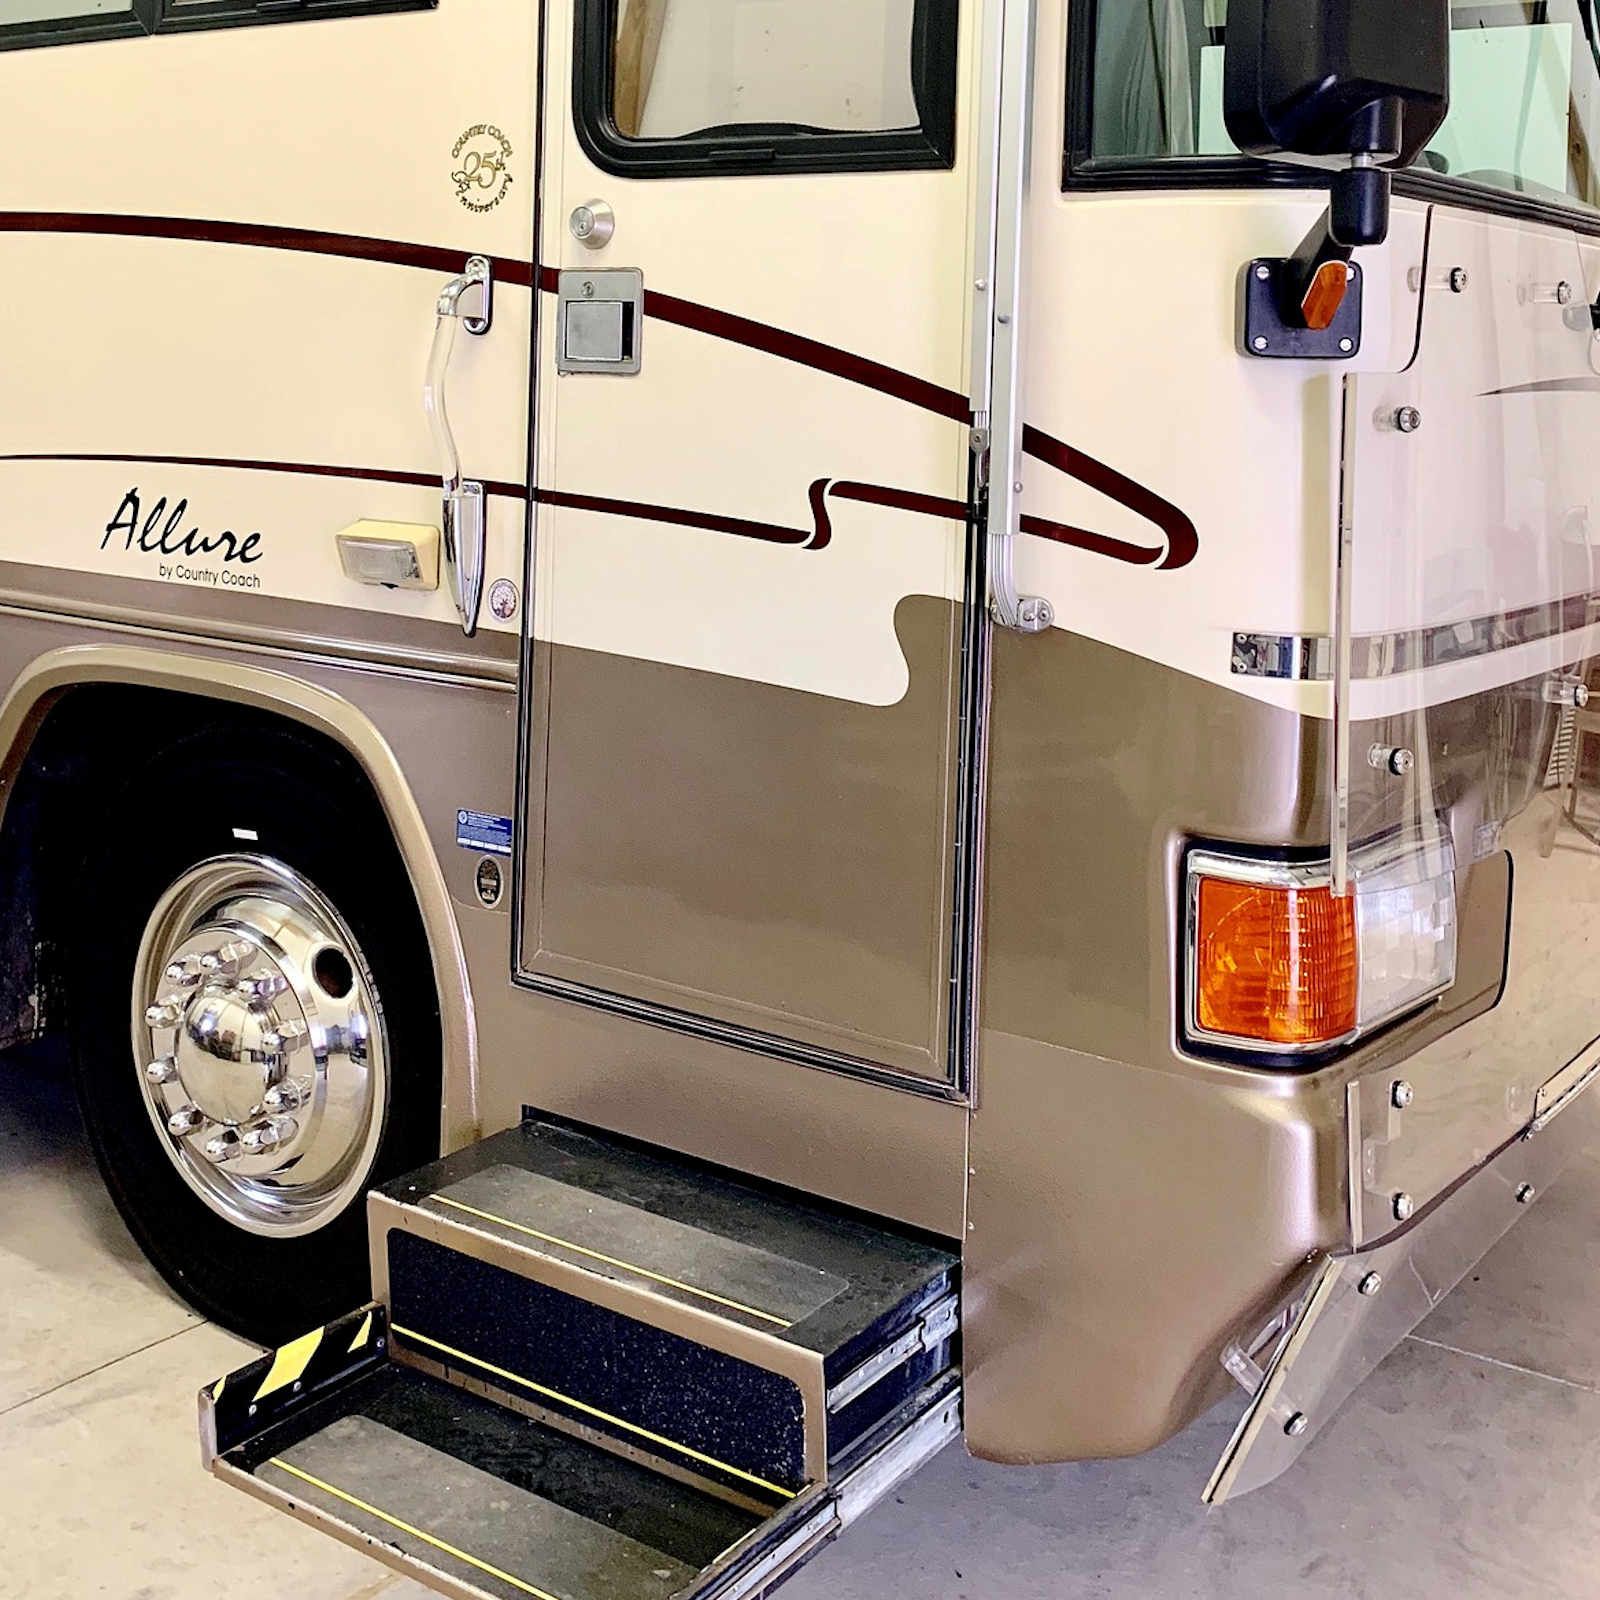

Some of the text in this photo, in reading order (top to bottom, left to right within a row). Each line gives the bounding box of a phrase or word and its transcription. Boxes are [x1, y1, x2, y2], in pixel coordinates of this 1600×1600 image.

[487, 125, 513, 157] COACH
[100, 487, 263, 564] Allure
[159, 563, 261, 588] by Country Coach
